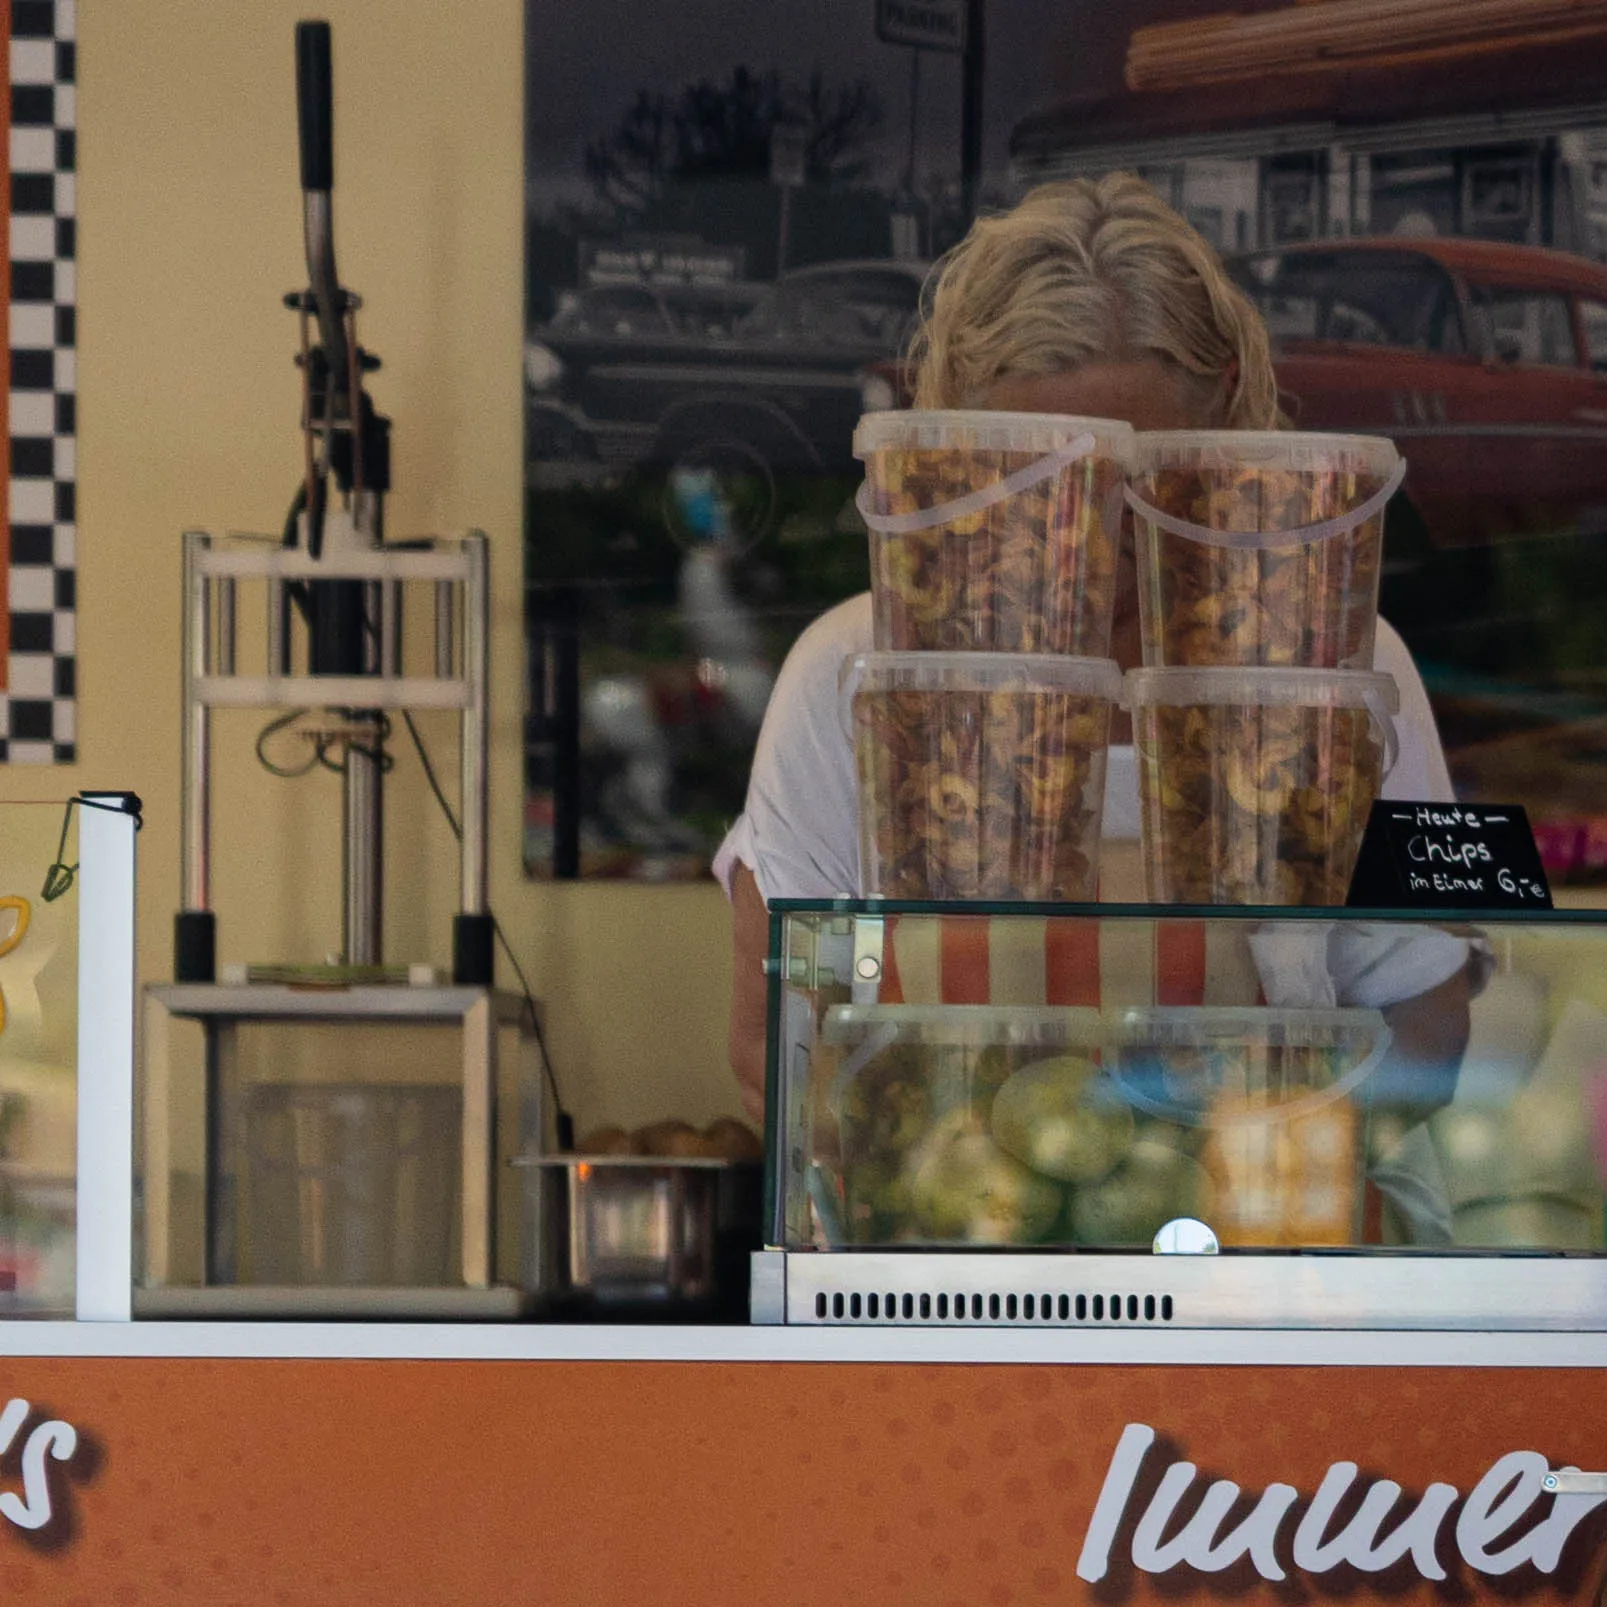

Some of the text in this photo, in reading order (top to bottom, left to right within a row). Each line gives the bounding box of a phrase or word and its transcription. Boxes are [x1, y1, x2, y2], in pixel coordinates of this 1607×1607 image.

[1415, 806, 1482, 828] Heute
[1407, 833, 1493, 869] Chips
[1432, 872, 1484, 892] Eimer
